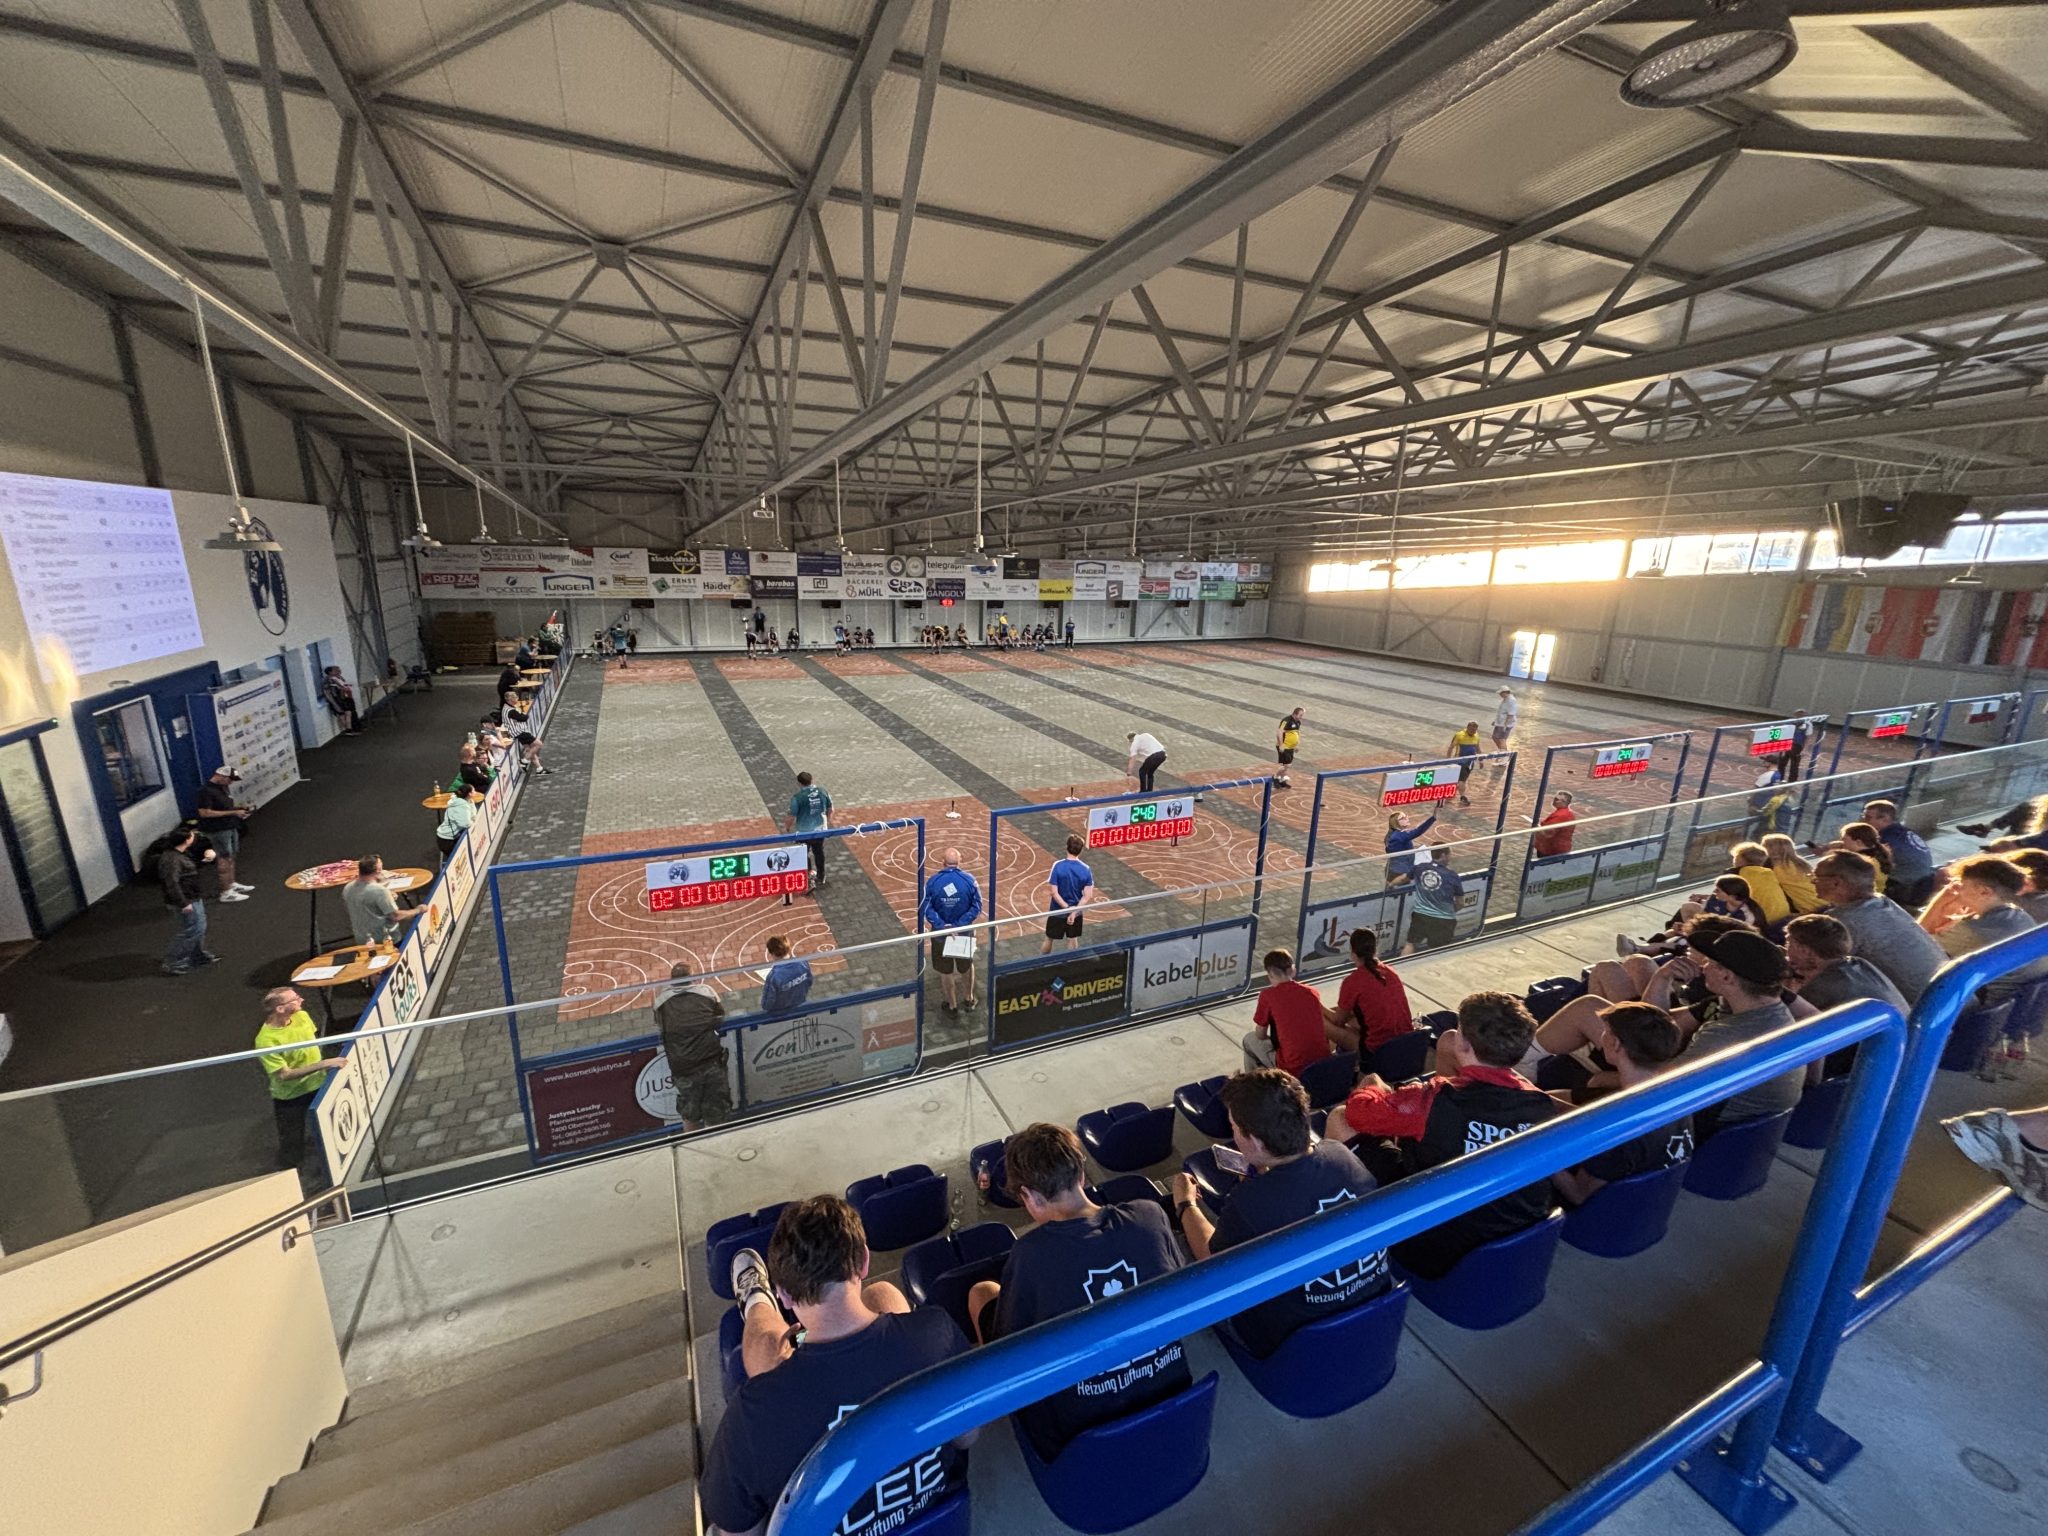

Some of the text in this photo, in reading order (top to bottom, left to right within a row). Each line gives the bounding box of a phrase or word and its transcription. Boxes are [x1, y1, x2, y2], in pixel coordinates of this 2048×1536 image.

[703, 582, 731, 590] Haider
[858, 586, 884, 597] MÜHL
[1131, 805, 1155, 822] 248
[711, 857, 749, 879] 221
[650, 872, 805, 910] 02 00 00 00 00 00
[1143, 952, 1239, 989] kabelplus
[998, 974, 1124, 1015] EASY DRIVERS
[544, 1059, 632, 1084] www.kosmetikjustyna.at
[548, 1108, 576, 1120] Justyna
[1305, 1290, 1345, 1304] Heizung
[1077, 1377, 1118, 1396] Heizung
[1118, 1361, 1154, 1390] Lüftung
[1154, 1346, 1182, 1372] Sanitär
[832, 1446, 945, 1535] LEE
